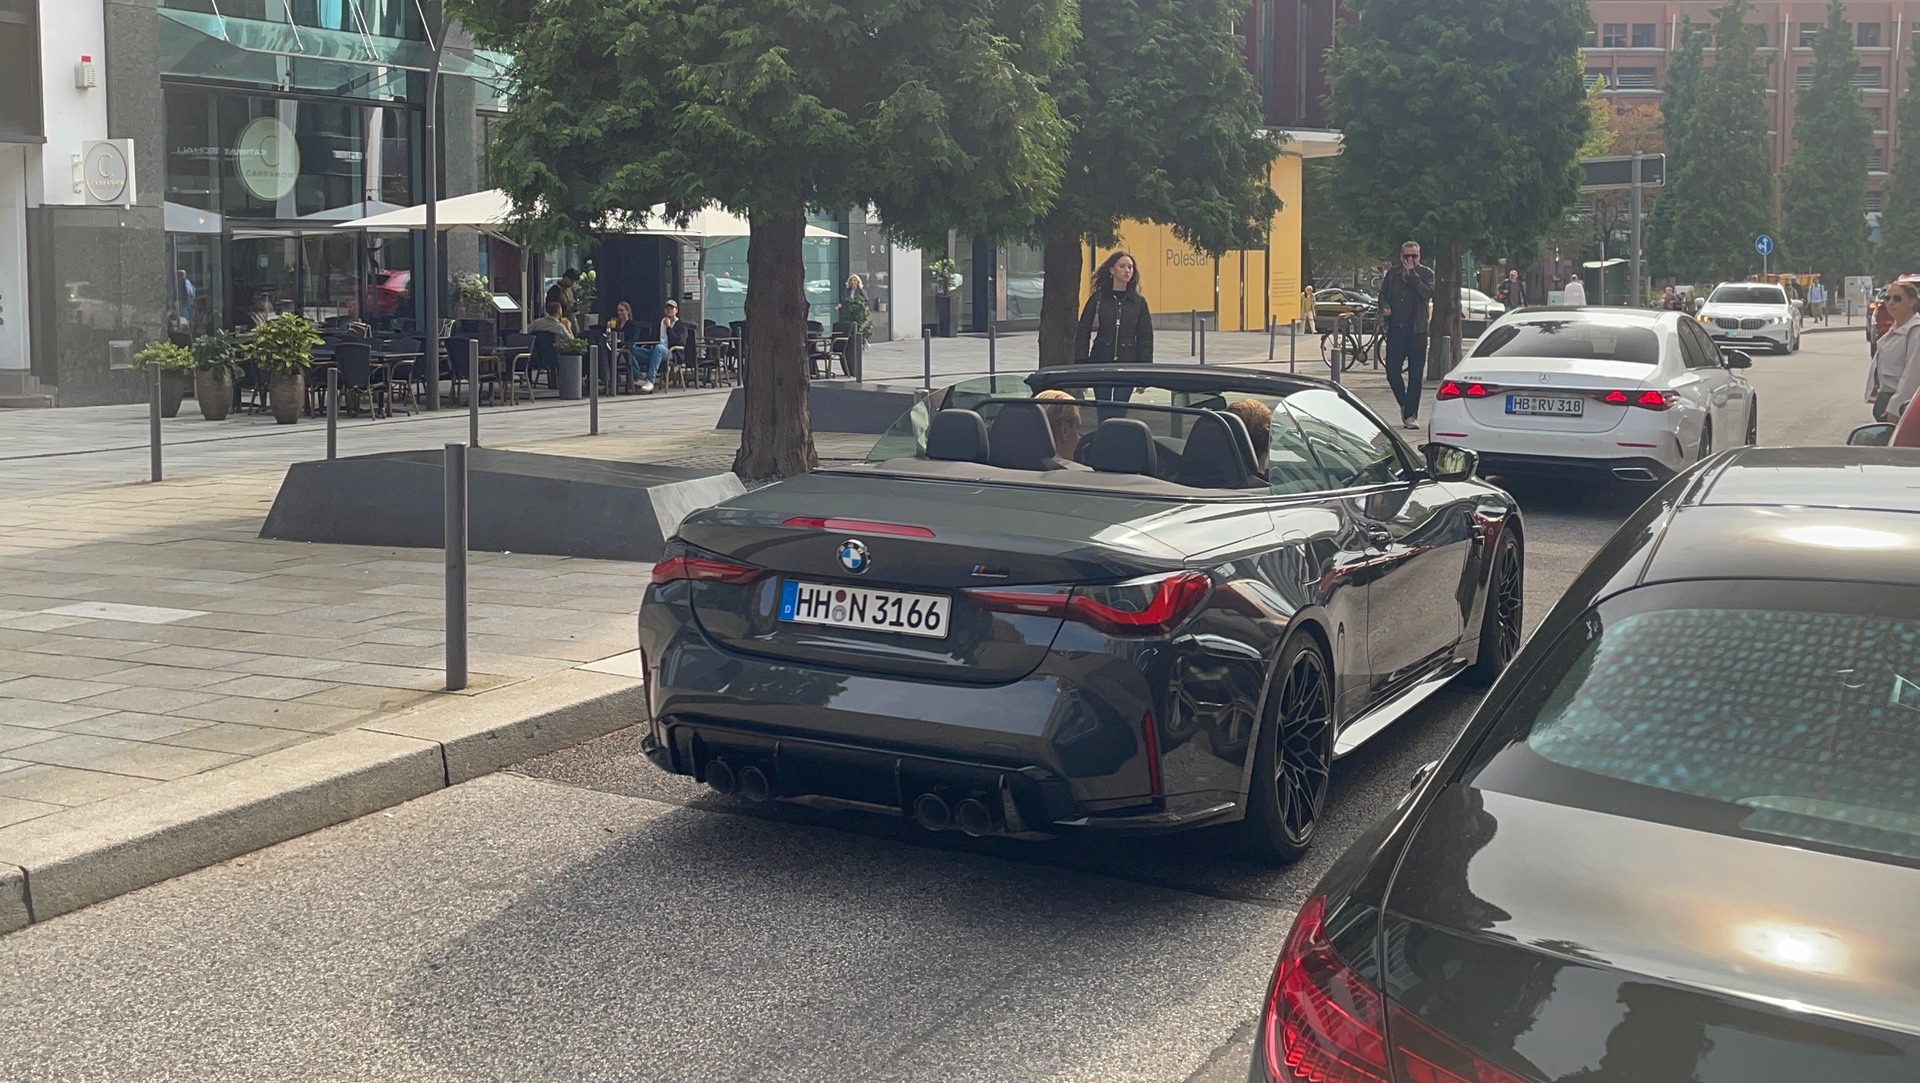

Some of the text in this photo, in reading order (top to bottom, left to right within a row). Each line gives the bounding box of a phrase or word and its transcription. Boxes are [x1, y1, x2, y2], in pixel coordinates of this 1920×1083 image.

[98, 153, 114, 178] C
[1514, 398, 1581, 412] HB RV 318
[796, 588, 832, 619] HH
[848, 593, 868, 623] N
[871, 595, 941, 631] 3166
